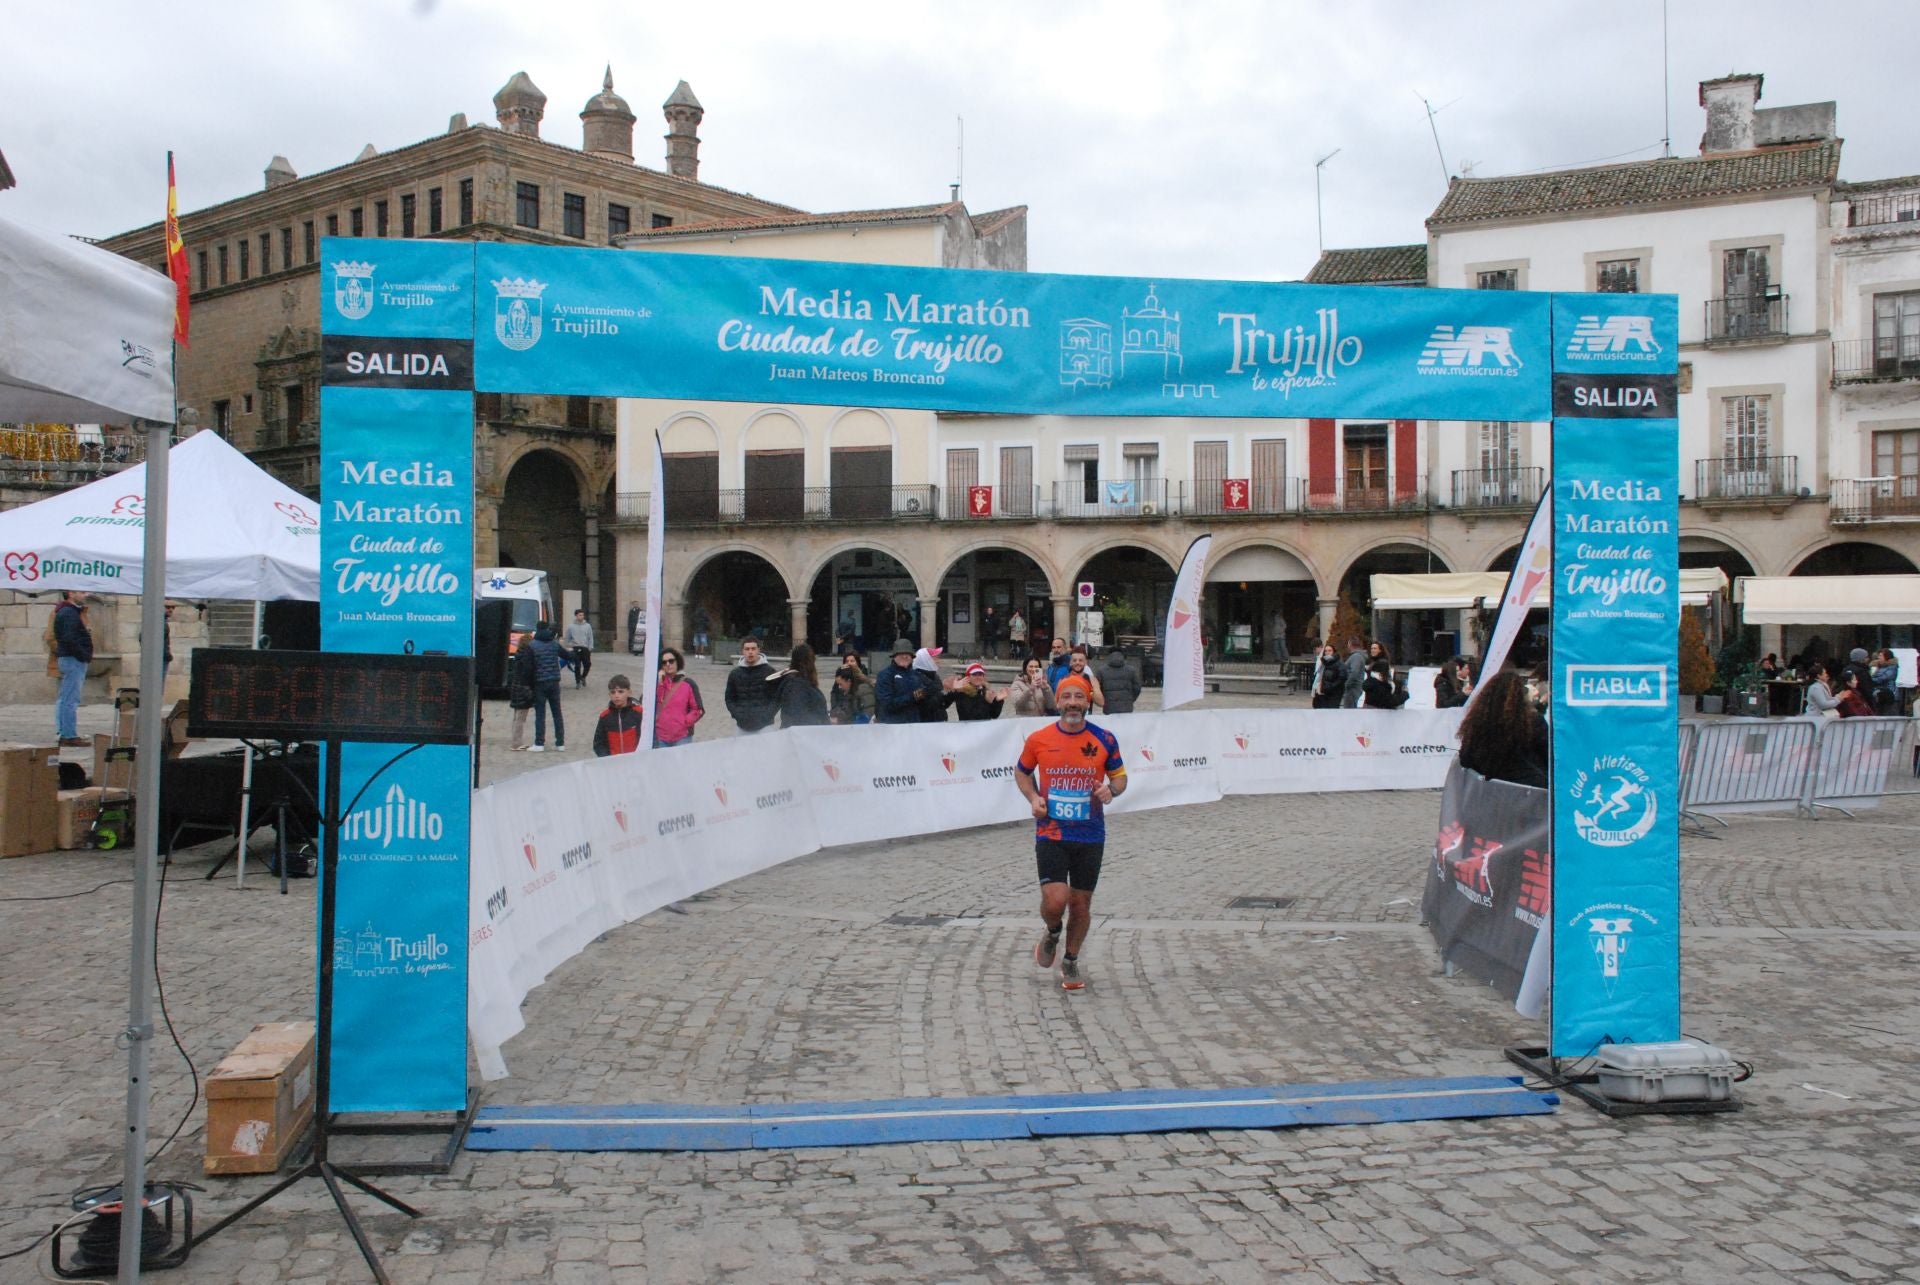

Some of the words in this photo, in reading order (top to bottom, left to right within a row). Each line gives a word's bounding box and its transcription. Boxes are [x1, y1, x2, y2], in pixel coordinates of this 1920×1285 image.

[381, 281, 447, 293] Ayuntamiento
[448, 282, 461, 292] de
[380, 293, 434, 309] Trujillo
[552, 303, 635, 317] Ayuntamiento
[637, 307, 652, 318] de
[759, 285, 873, 321] Media
[884, 292, 1031, 328] Maratón
[551, 317, 619, 338] Trujillo
[717, 319, 835, 356] Ciudad
[840, 328, 882, 358] de
[890, 327, 1004, 373] Trujillo
[1217, 307, 1363, 380] Trujillo
[346, 351, 449, 376] SALIDA
[1566, 351, 1657, 361] www.musicrun.es
[768, 363, 806, 381] Juan
[811, 365, 868, 382] Mateos
[873, 368, 945, 386] Broncano
[1251, 368, 1268, 391] te
[1416, 364, 1519, 377] www.musicrun.es
[1574, 386, 1658, 407] SALIDA
[340, 460, 454, 487] Media
[1570, 479, 1662, 502] Media
[333, 500, 463, 525] Maratón
[1564, 513, 1669, 534] Maratón
[350, 534, 416, 554] Ciudad
[419, 537, 444, 554] de
[1577, 542, 1630, 560] Ciudad
[1632, 546, 1653, 560] de
[42, 559, 123, 578] primaflor
[333, 557, 459, 607] Trujillo
[1563, 563, 1667, 606] Trujillo
[338, 611, 362, 622] Juan
[366, 611, 403, 621] Mateos
[406, 612, 456, 622] Broncano
[1567, 609, 1588, 619] Juan
[1590, 609, 1622, 619] Mateos
[1623, 609, 1665, 619] Broncano
[1580, 677, 1652, 695] HABLA
[1046, 764, 1097, 775] canicross
[1569, 769, 1588, 799] Club
[1593, 754, 1650, 782] Atletismo
[1055, 802, 1082, 818] 561
[428, 853, 459, 863] MAGIA
[1569, 911, 1585, 927] Club
[1623, 904, 1639, 914] San
[385, 933, 448, 961] Trujillo
[1596, 938, 1604, 953] A
[1617, 937, 1626, 953] J
[405, 961, 414, 973] te
[1607, 953, 1615, 968] S
